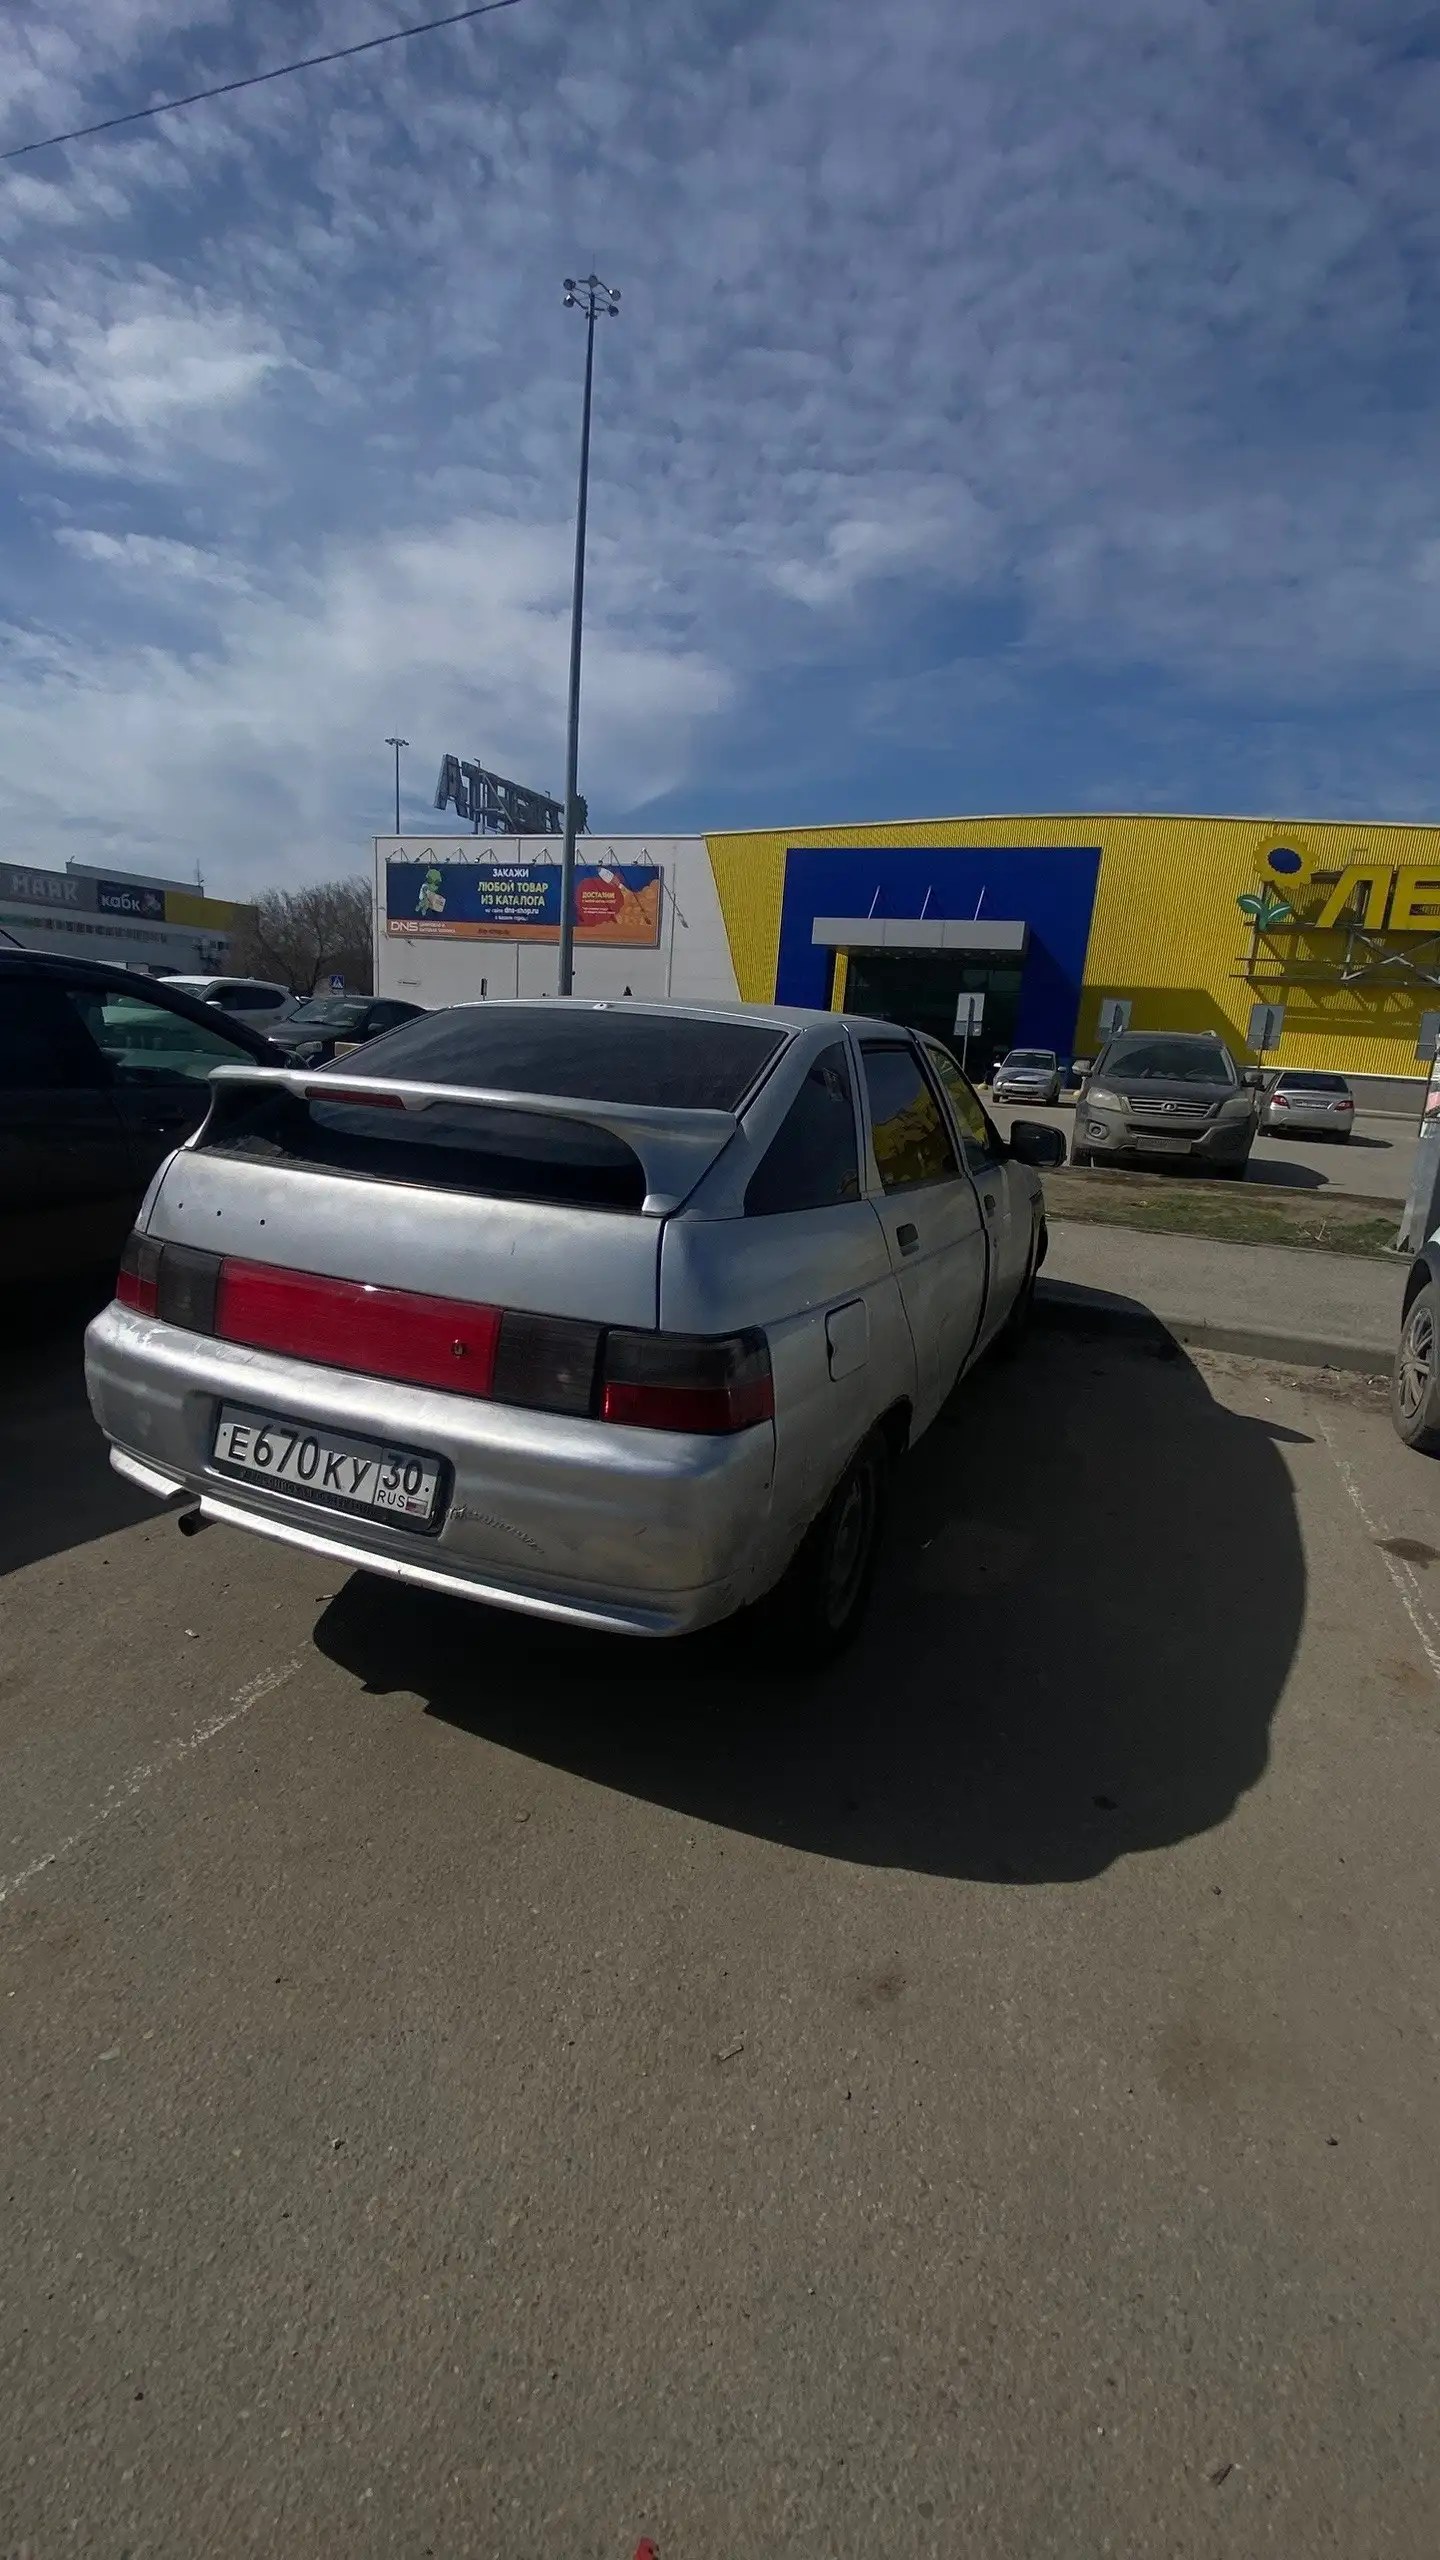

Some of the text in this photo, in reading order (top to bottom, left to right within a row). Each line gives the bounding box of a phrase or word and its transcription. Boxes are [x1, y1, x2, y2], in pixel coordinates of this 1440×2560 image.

[492, 868, 529, 878] ЗАКАЖИ
[477, 880, 549, 893] ЛЮБОЙ ТОВАР
[481, 894, 545, 906] ИЗ КАТАЛОГА
[390, 921, 418, 933] DNS
[382, 1452, 423, 1496] 30
[376, 1489, 406, 1509] RUS
